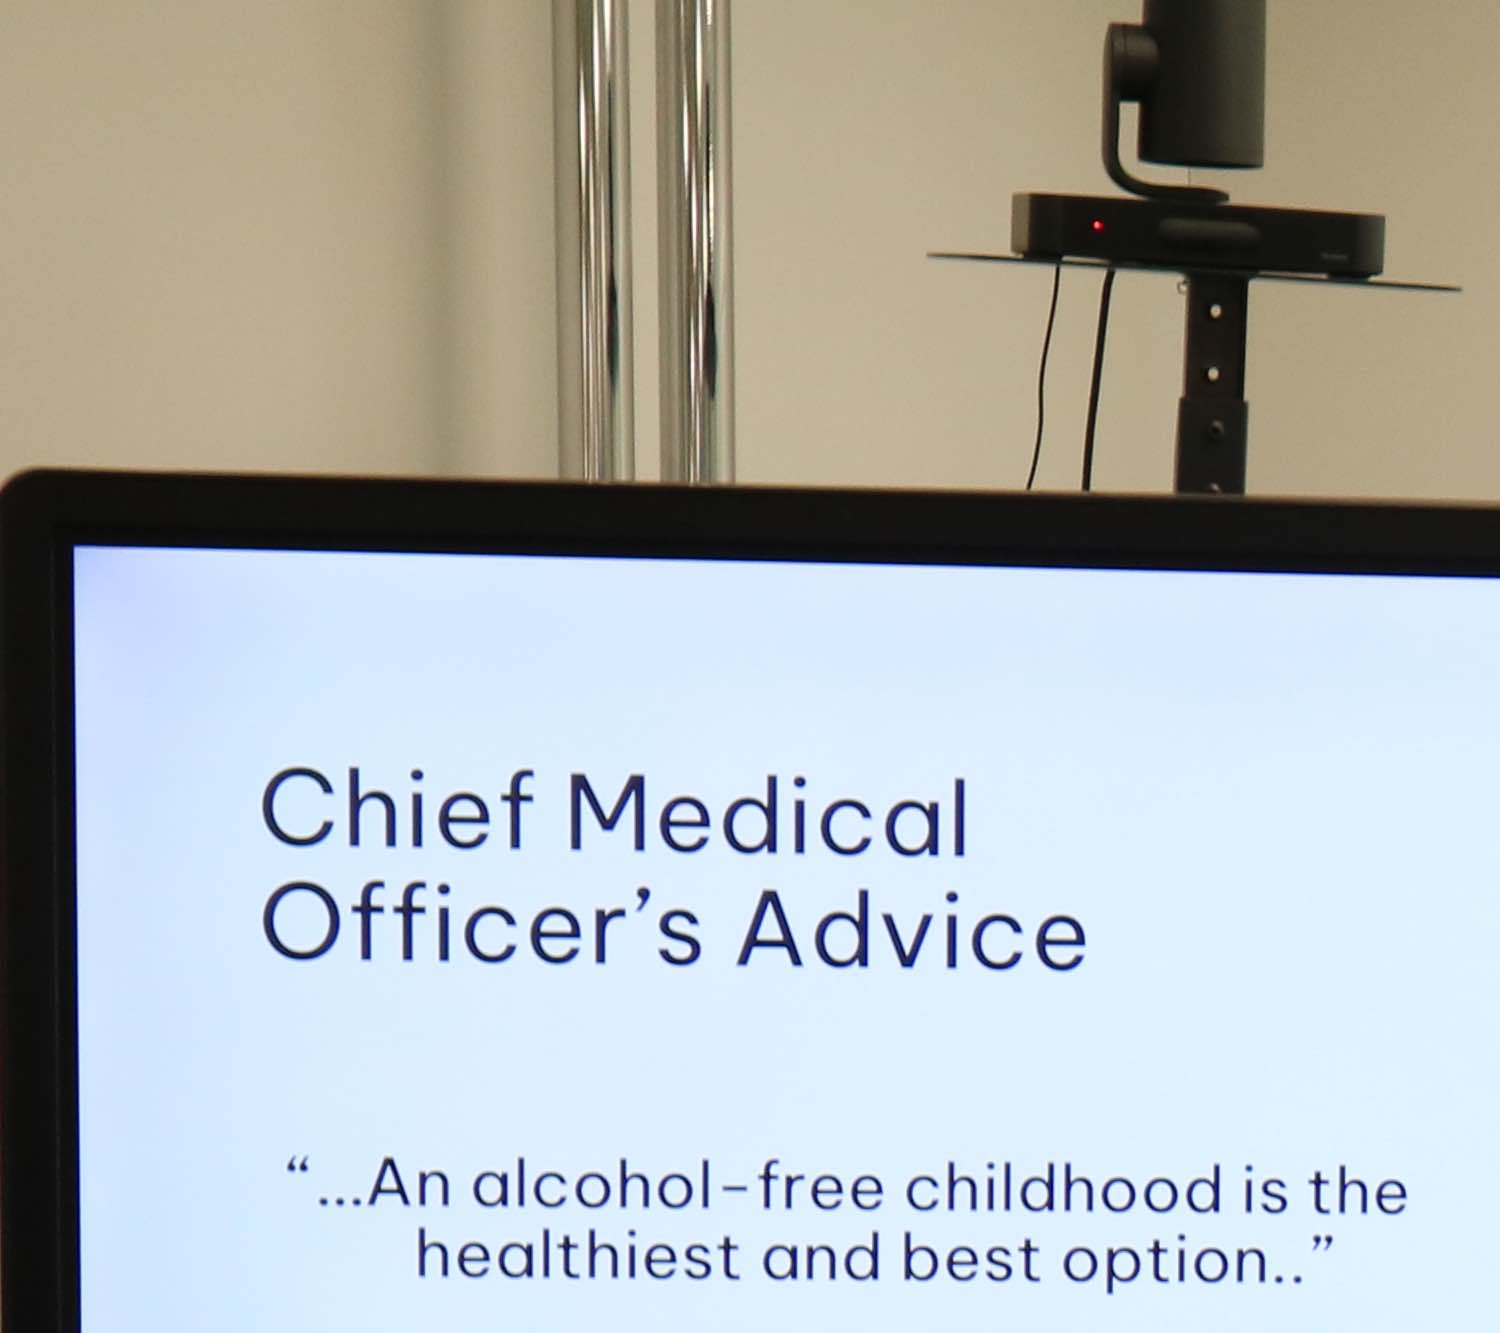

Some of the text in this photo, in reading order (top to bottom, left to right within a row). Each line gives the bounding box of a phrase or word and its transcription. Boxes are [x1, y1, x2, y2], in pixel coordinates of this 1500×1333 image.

[261, 765, 966, 859] Chief Medical
[262, 879, 1087, 973] Officer’s Advice
[472, 1157, 884, 1212] alcohol-free
[905, 1160, 1221, 1215] childhood
[1244, 1163, 1289, 1215] is
[1307, 1164, 1408, 1216] the
[417, 1226, 741, 1281] healthiest
[762, 1229, 880, 1282] and
[903, 1230, 1041, 1284] best
